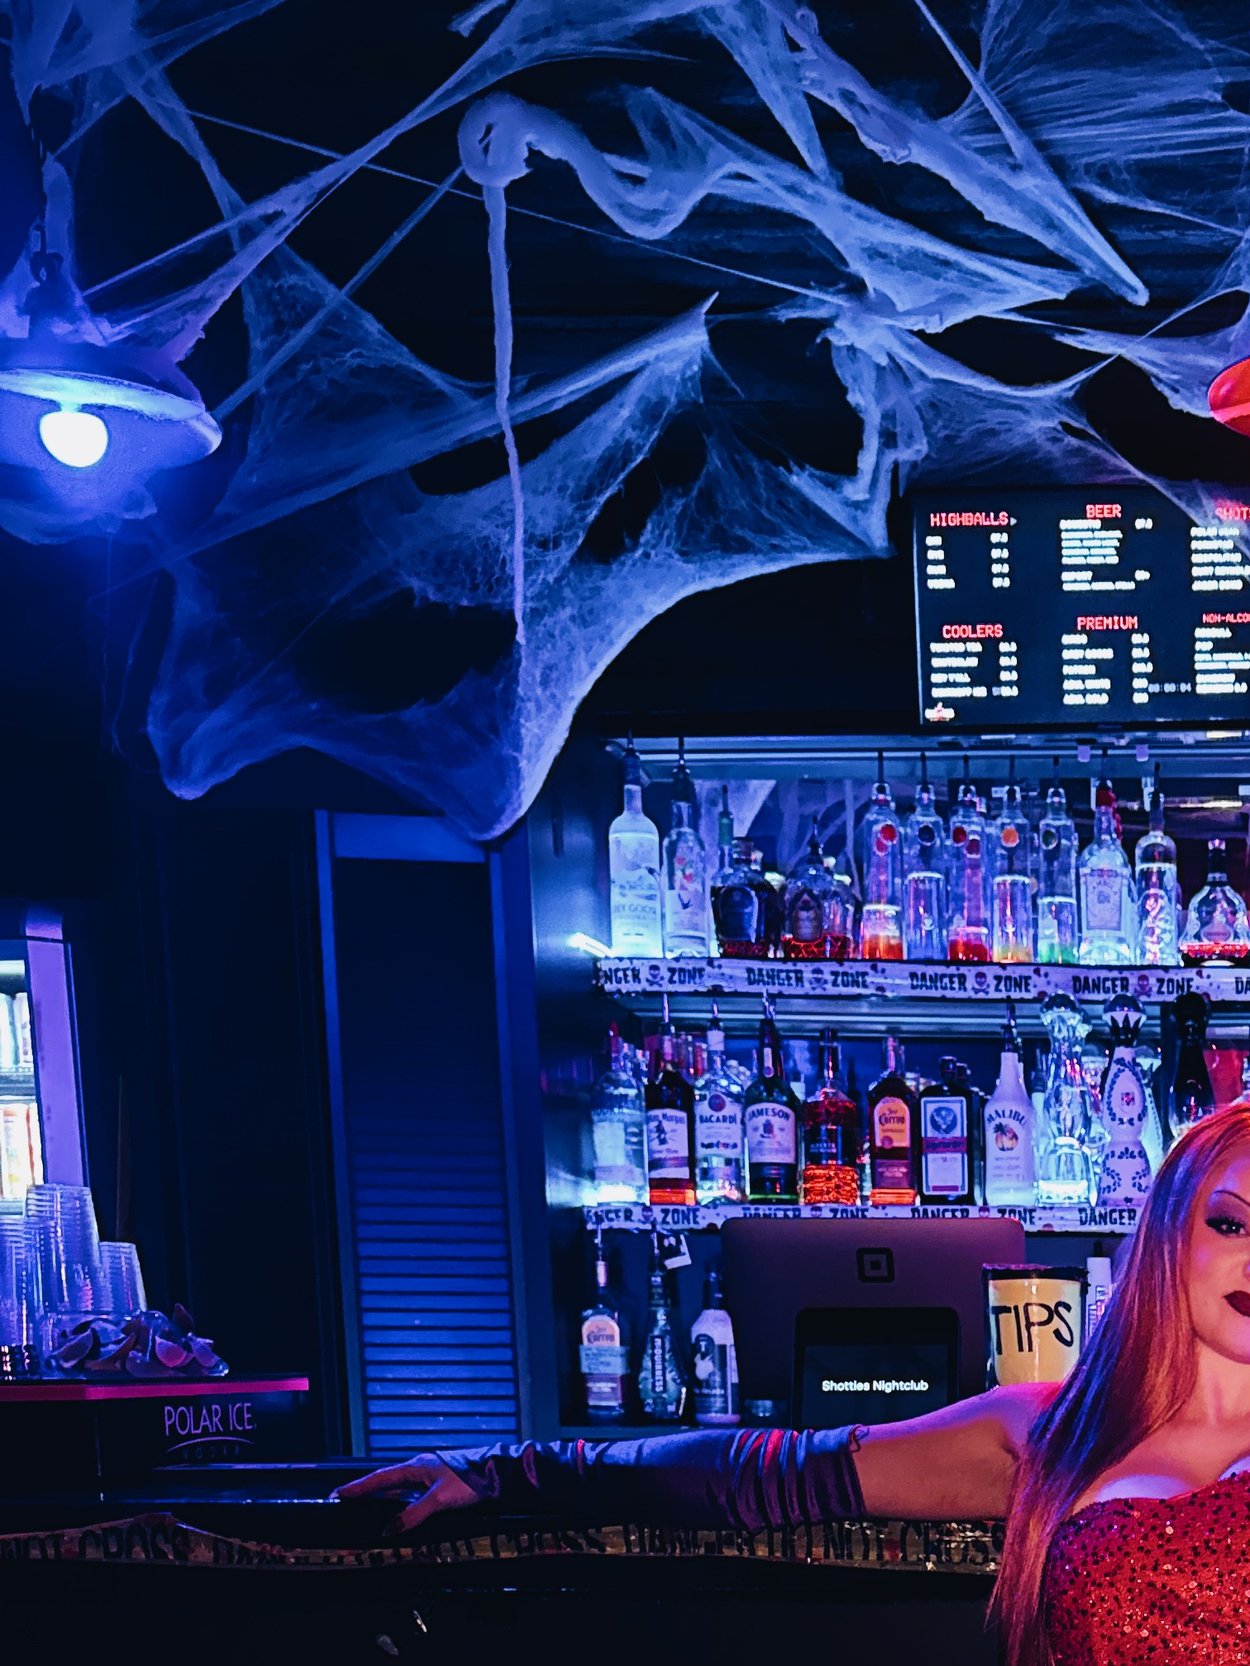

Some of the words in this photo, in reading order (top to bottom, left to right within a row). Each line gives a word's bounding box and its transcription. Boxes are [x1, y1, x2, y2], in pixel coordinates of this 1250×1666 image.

[930, 512, 1009, 527] HIGHBALLS
[1086, 504, 1122, 518] BEER
[942, 624, 1004, 639] COOLERS
[1077, 616, 1138, 630] PREMIUM
[604, 966, 640, 985] NGER
[667, 966, 704, 985] ZONE
[746, 966, 804, 987] DANGER
[831, 971, 868, 989] ZONE
[909, 971, 967, 992] DANGER
[994, 974, 1031, 994] ZONE
[1072, 976, 1129, 995] DANGER
[1156, 976, 1193, 996] ZONE
[748, 1107, 791, 1122] JAMESON
[986, 1108, 1029, 1127] MALIBU
[661, 1208, 700, 1225] ZONE
[1079, 1208, 1136, 1226] DANGER
[991, 1300, 1075, 1355] TIPS
[822, 1380, 870, 1392] Shotties
[872, 1379, 929, 1394] Nightclub
[164, 1404, 224, 1437] POLAR
[229, 1402, 254, 1431] ICE
